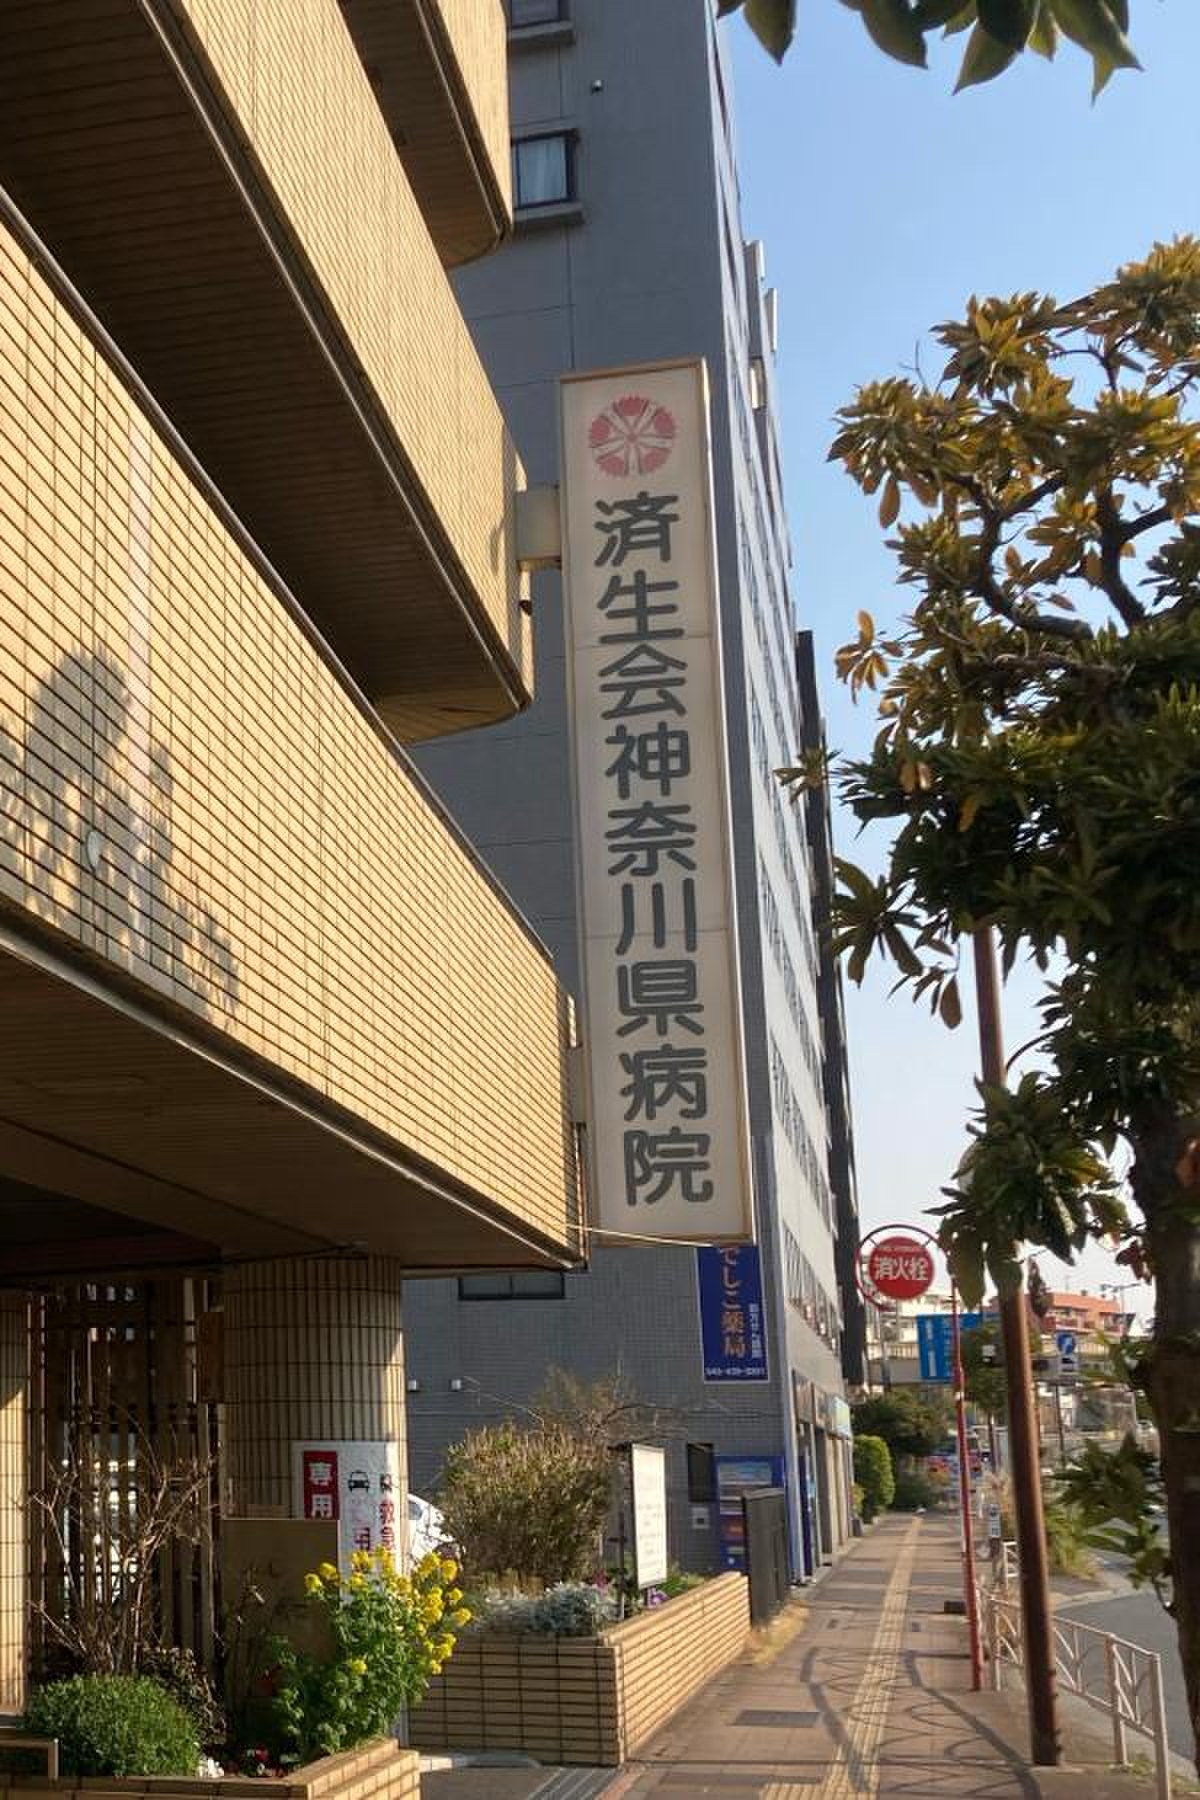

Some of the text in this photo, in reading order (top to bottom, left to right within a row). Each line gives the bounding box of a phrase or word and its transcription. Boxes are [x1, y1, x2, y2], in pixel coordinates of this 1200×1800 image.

[595, 491, 714, 1207] 済生会神奈川県病院
[874, 1256, 929, 1281] 消火栓
[308, 1461, 333, 1518] 専用
